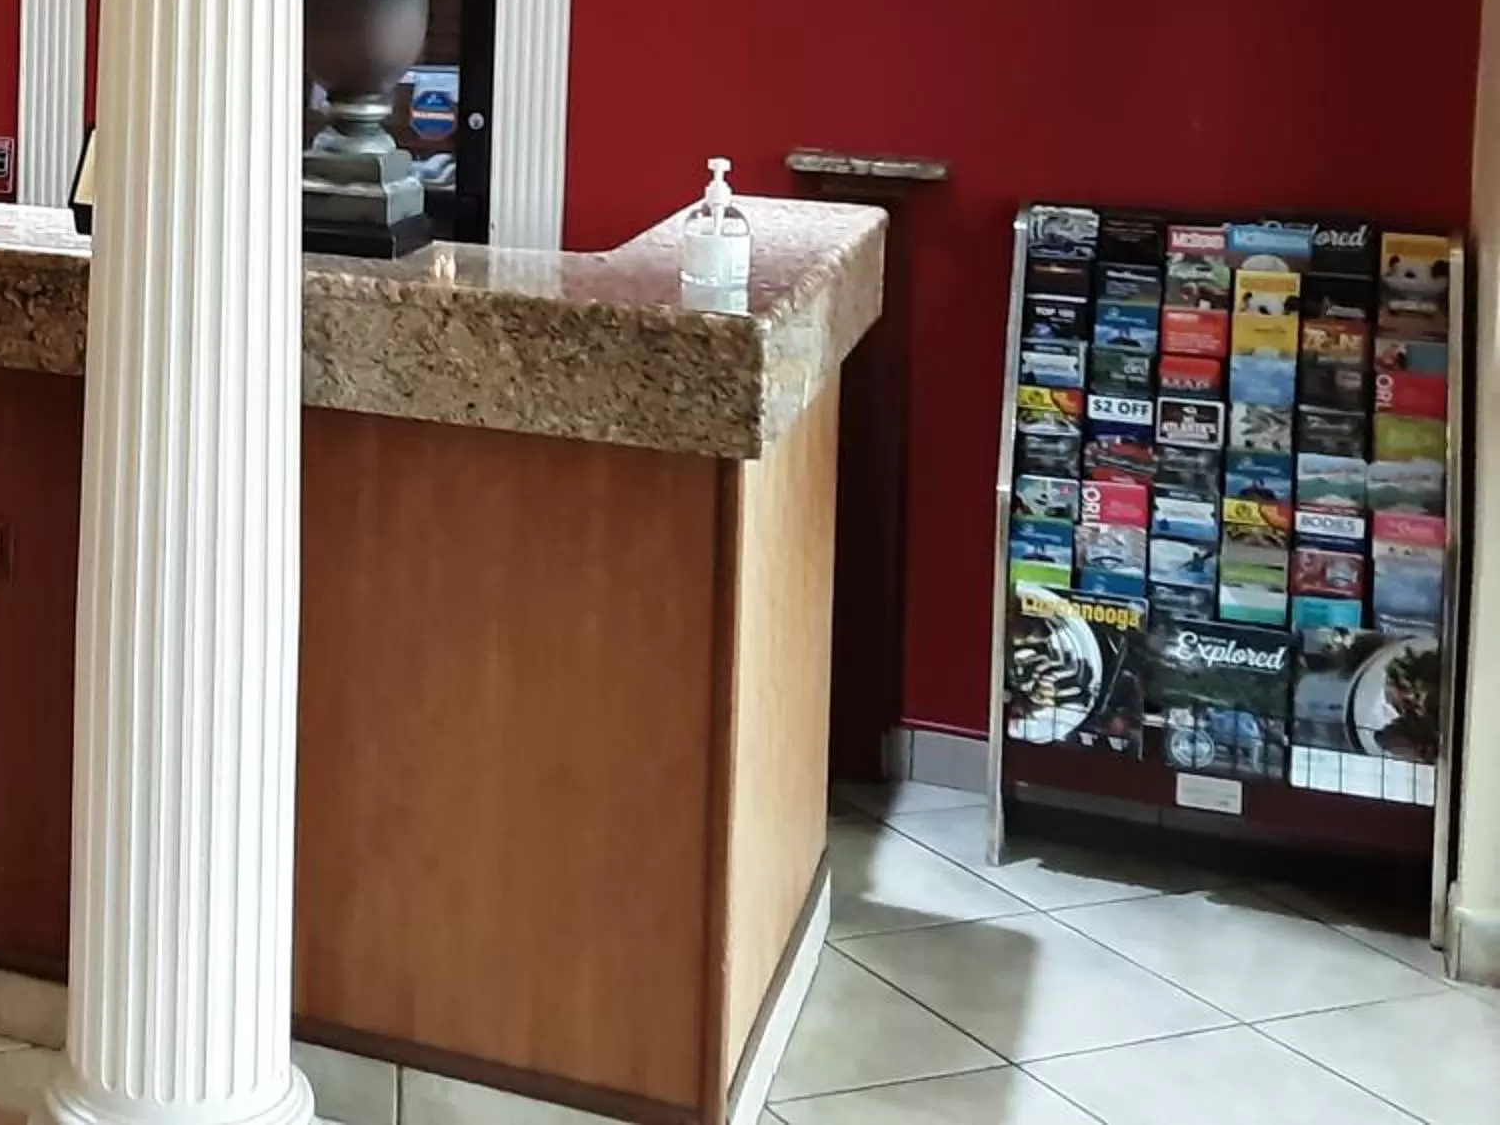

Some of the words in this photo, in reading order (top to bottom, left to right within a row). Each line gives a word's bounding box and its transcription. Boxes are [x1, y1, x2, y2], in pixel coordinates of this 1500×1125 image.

[1093, 398, 1113, 413] $2
[1117, 400, 1149, 417] OFF
[1175, 630, 1287, 671] Explored
